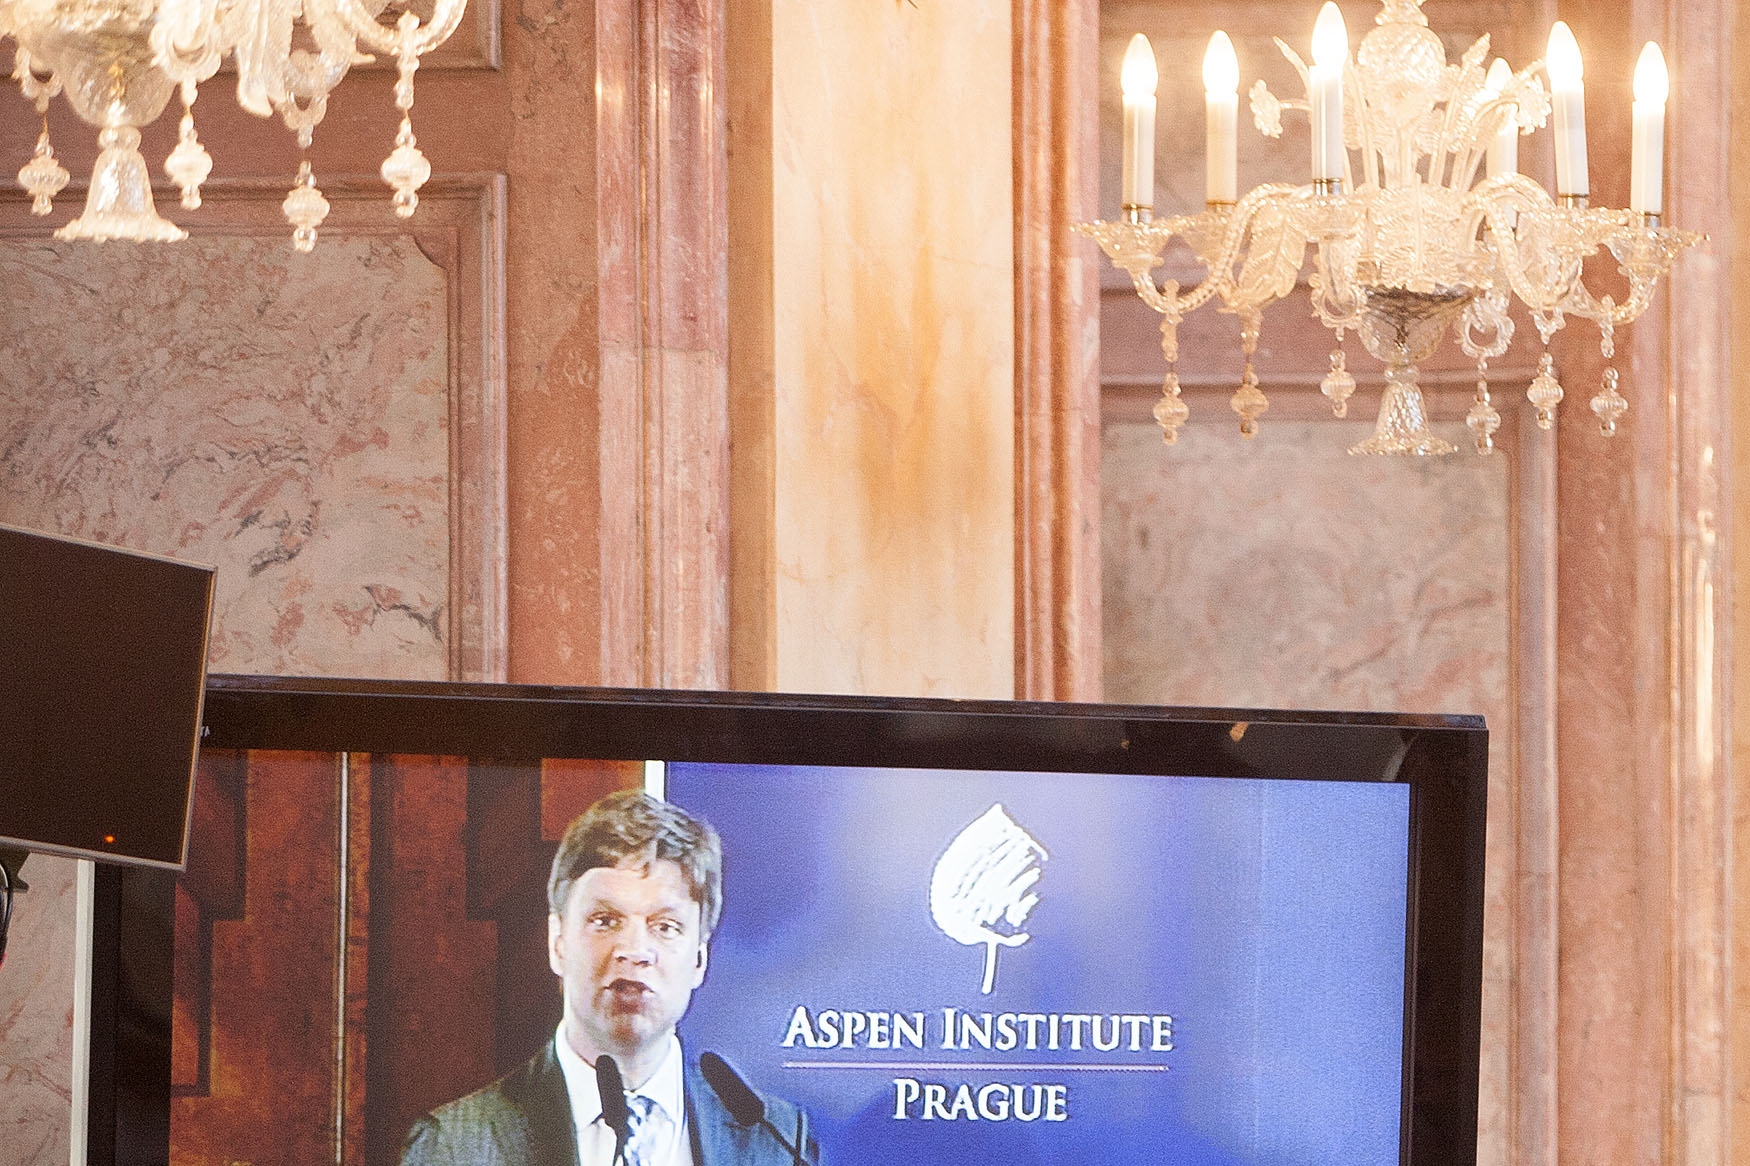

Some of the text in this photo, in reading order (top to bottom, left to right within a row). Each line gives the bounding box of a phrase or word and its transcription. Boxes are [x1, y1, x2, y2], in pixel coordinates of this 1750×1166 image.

[782, 1005, 1174, 1052] ASPEN INSTITUTE
[893, 1077, 1069, 1122] PRAGUE
